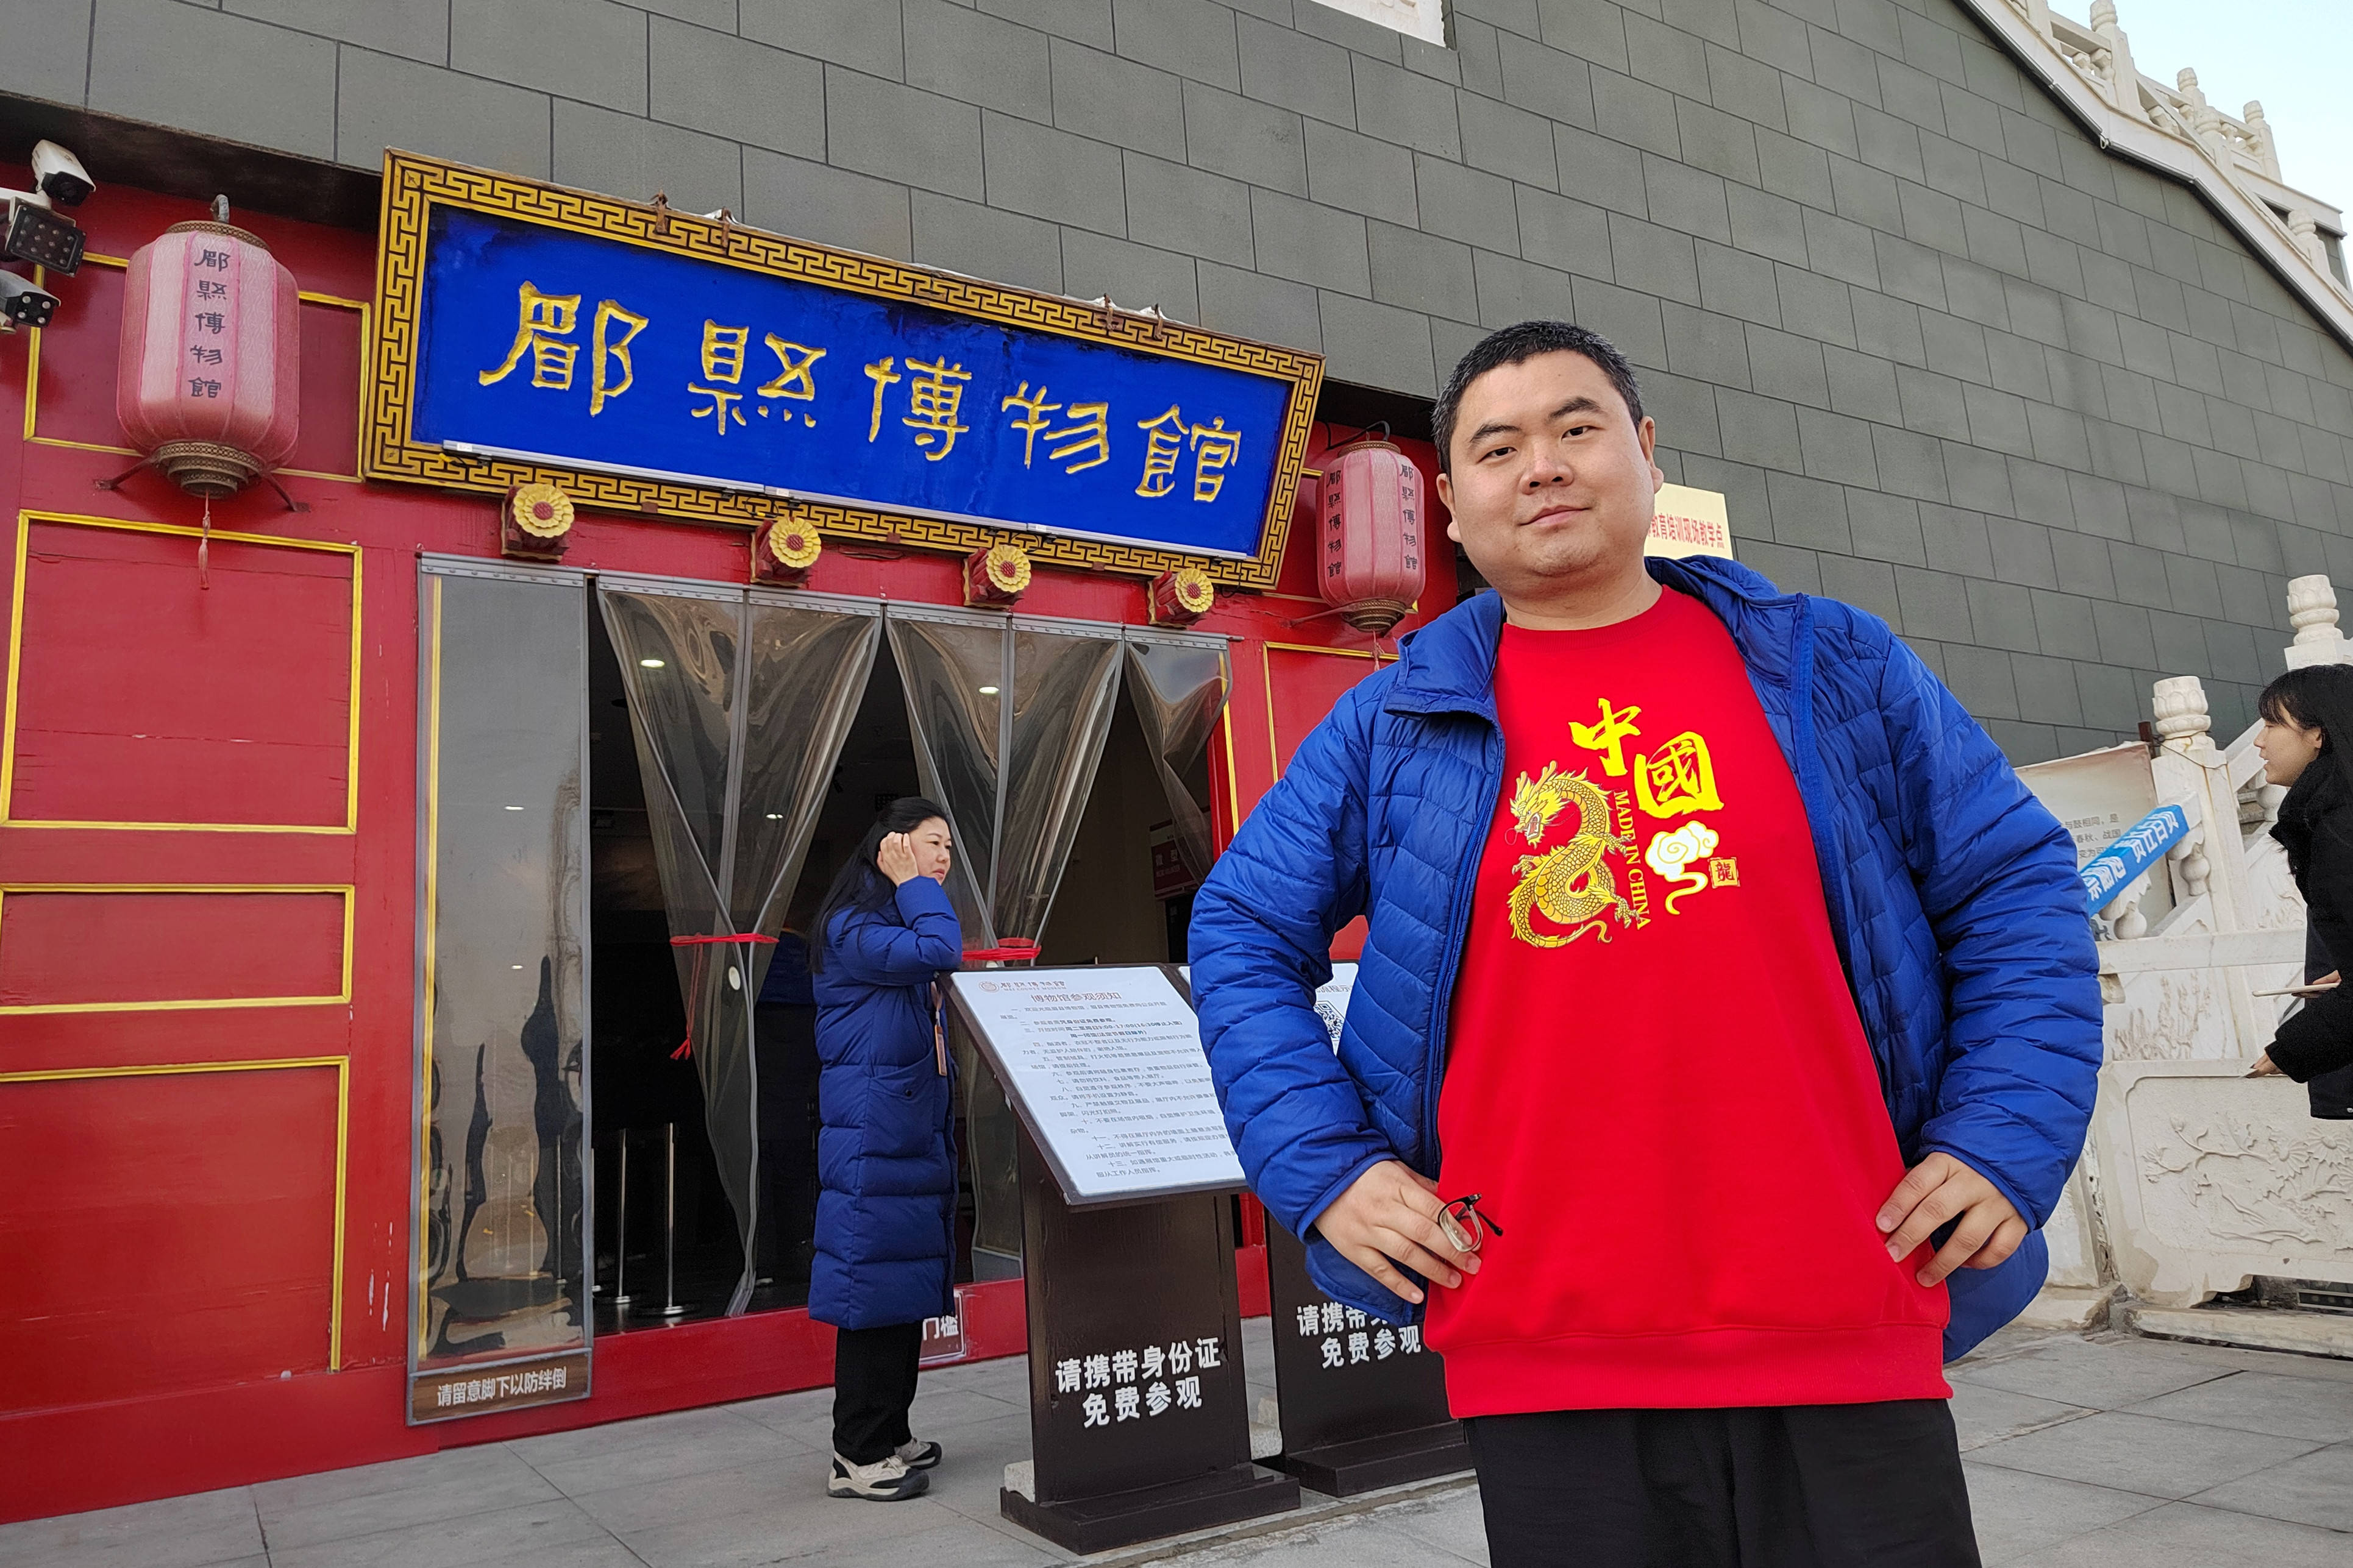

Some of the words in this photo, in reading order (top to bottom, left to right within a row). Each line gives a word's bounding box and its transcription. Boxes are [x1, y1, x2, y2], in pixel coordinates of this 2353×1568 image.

[1648, 513, 1725, 548] 教育培训现场教学点
[1614, 789, 1636, 840] MADE
[1626, 844, 1641, 865] IN
[1628, 868, 1651, 931] CHINA
[1031, 992, 1122, 1002] 博物馆参观须知
[1055, 1336, 1221, 1394] 请携带身份证
[1320, 1324, 1422, 1369] 免费参观
[436, 1366, 567, 1407] 请留意脚下以防绊倒
[1082, 1375, 1203, 1428] 免费参观
